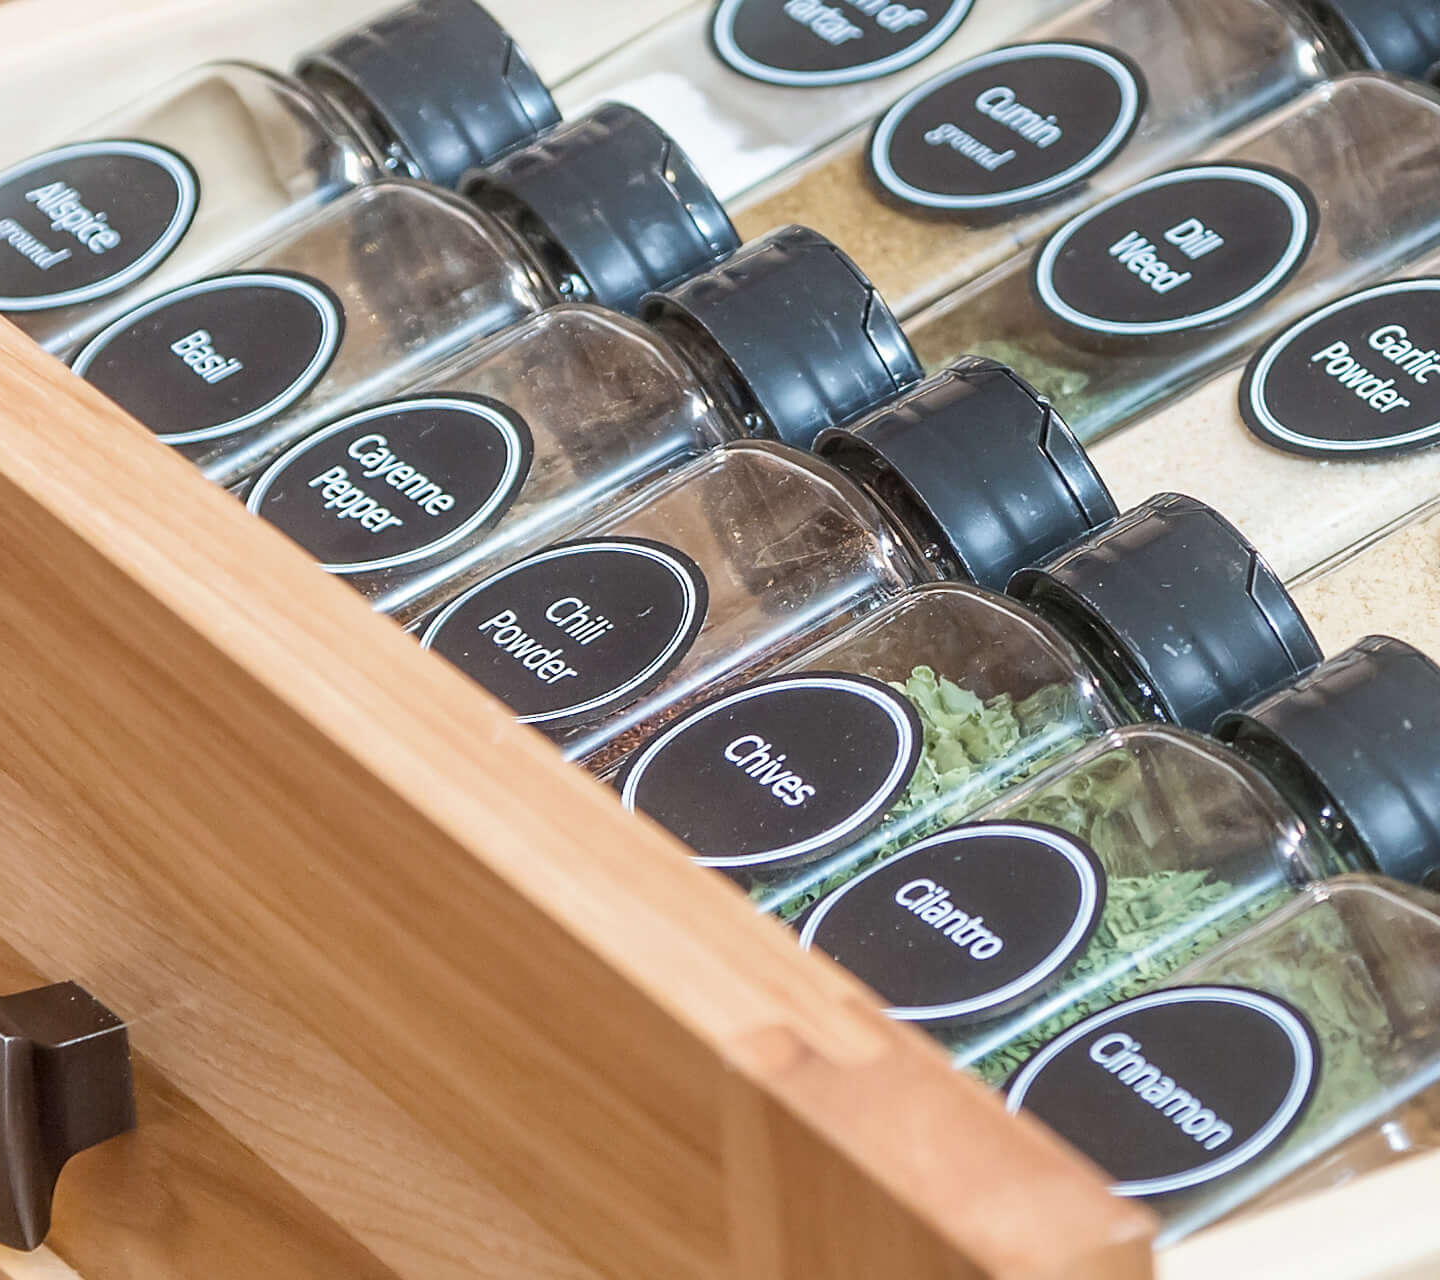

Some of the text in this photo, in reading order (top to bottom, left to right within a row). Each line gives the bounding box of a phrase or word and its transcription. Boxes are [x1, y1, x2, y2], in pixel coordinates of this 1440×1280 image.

[878, 4, 929, 35] of
[923, 123, 1016, 174] ground
[975, 85, 1064, 149] Cumin
[25, 180, 122, 255] Allspice
[1163, 218, 1225, 260] Dill
[1107, 230, 1192, 295] Weed
[170, 328, 244, 385] Basil
[1311, 342, 1410, 415] Powder
[308, 466, 403, 536] Pepper
[346, 433, 457, 517] Cayenne
[479, 610, 578, 686] Powder
[544, 594, 615, 646] Chili
[724, 733, 816, 807] Chives
[894, 878, 1005, 962] Cilantro
[1089, 1032, 1234, 1152] Cinnamon
